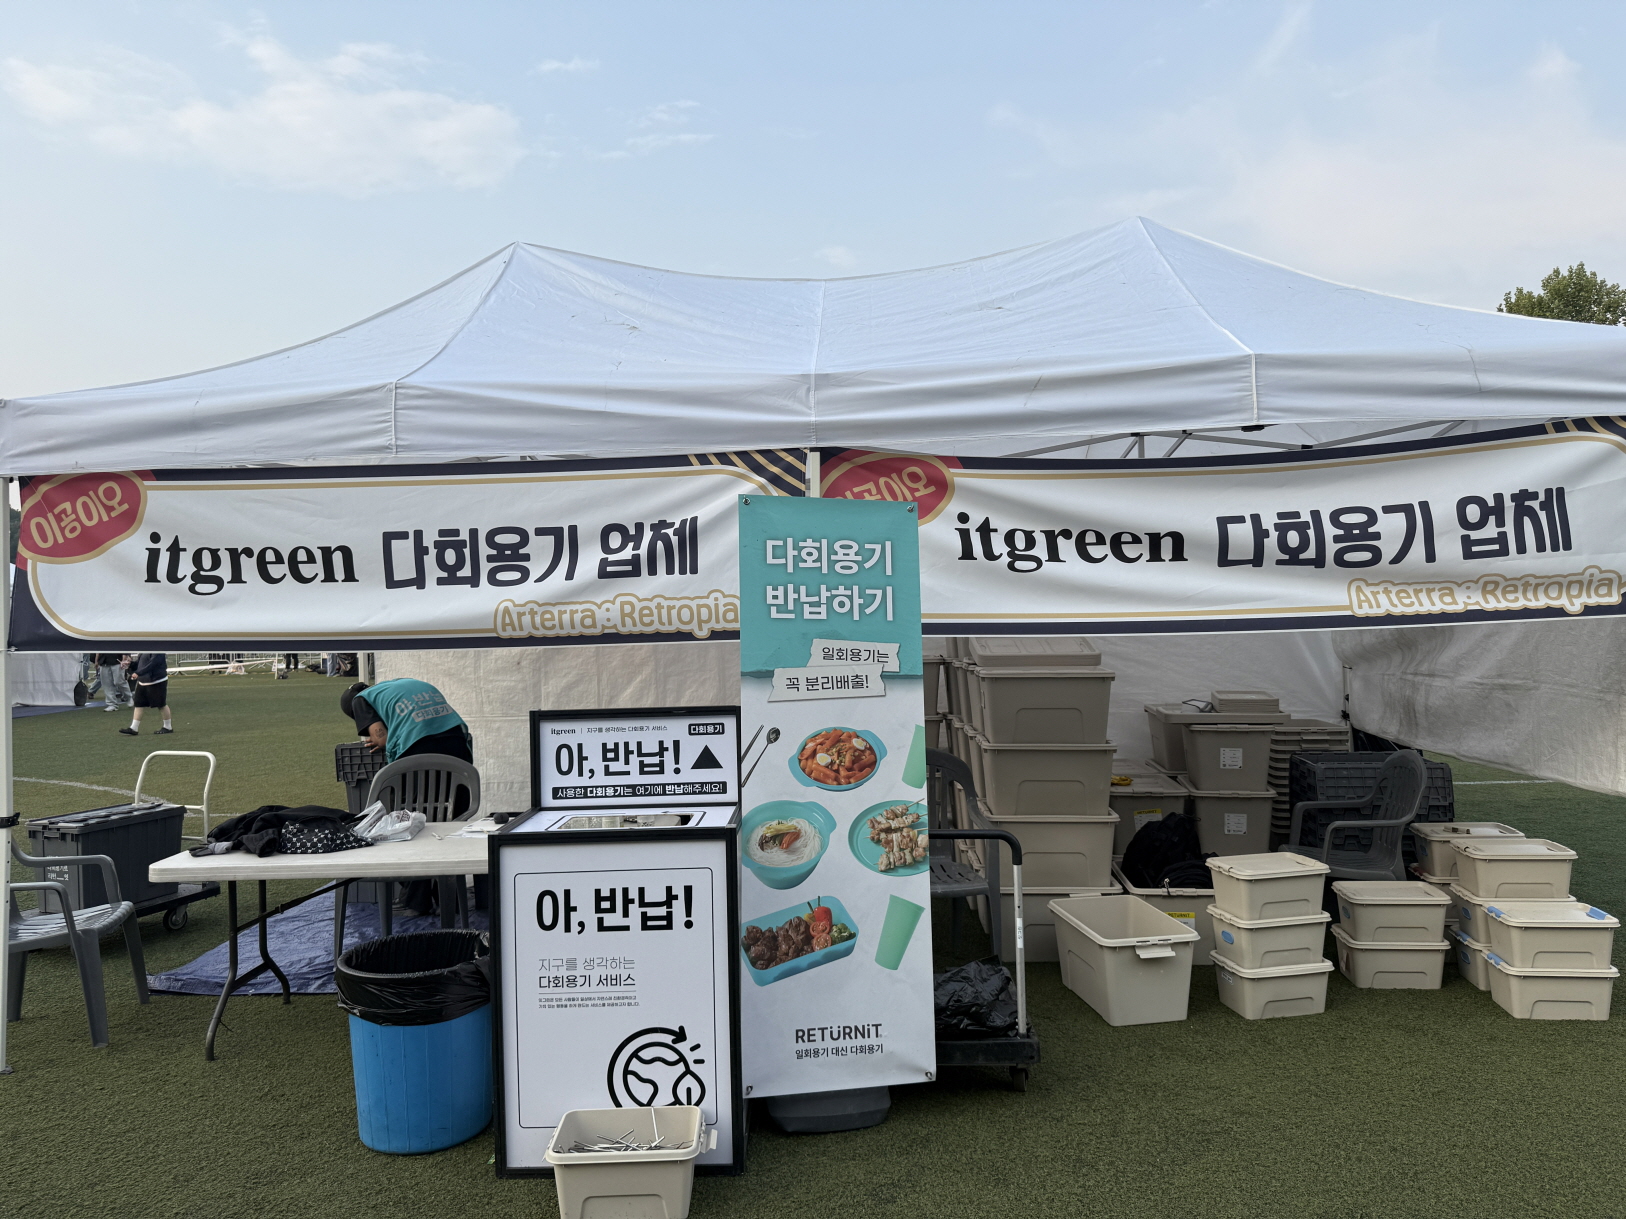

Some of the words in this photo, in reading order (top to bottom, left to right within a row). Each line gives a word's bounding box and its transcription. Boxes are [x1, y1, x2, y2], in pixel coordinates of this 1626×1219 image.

[30, 481, 129, 549] 이공이오
[954, 511, 1188, 573] itgreen
[1215, 500, 1437, 569] 다회용기
[1456, 486, 1573, 560] 업체
[144, 531, 360, 596] itgreen
[382, 524, 579, 590] 다회용기
[597, 515, 699, 580] 업체
[766, 537, 893, 576] 다회용기
[1480, 572, 1614, 607] Retropia
[766, 583, 894, 622] 반납하기
[619, 597, 739, 632] Retropia
[822, 646, 890, 663] 일회용기는
[785, 676, 800, 692] 꼭
[805, 674, 869, 692] 분리배출!
[416, 705, 449, 719] 다회용기
[550, 727, 576, 736] itgreen
[586, 726, 603, 734] 지구를
[690, 724, 723, 734] 다회용기
[556, 787, 585, 798] 사용한
[587, 786, 632, 797] 다회용기는
[635, 785, 663, 795] 여기에
[665, 783, 723, 795] 반납해주세요!
[538, 957, 578, 972] 지구를
[582, 956, 635, 971] 생각하는
[538, 974, 591, 989] 다회용기
[596, 973, 636, 988] 서비스
[795, 1046, 829, 1060] 일회용기
[831, 1045, 848, 1057] 대신
[850, 1043, 883, 1056] 다회용기
